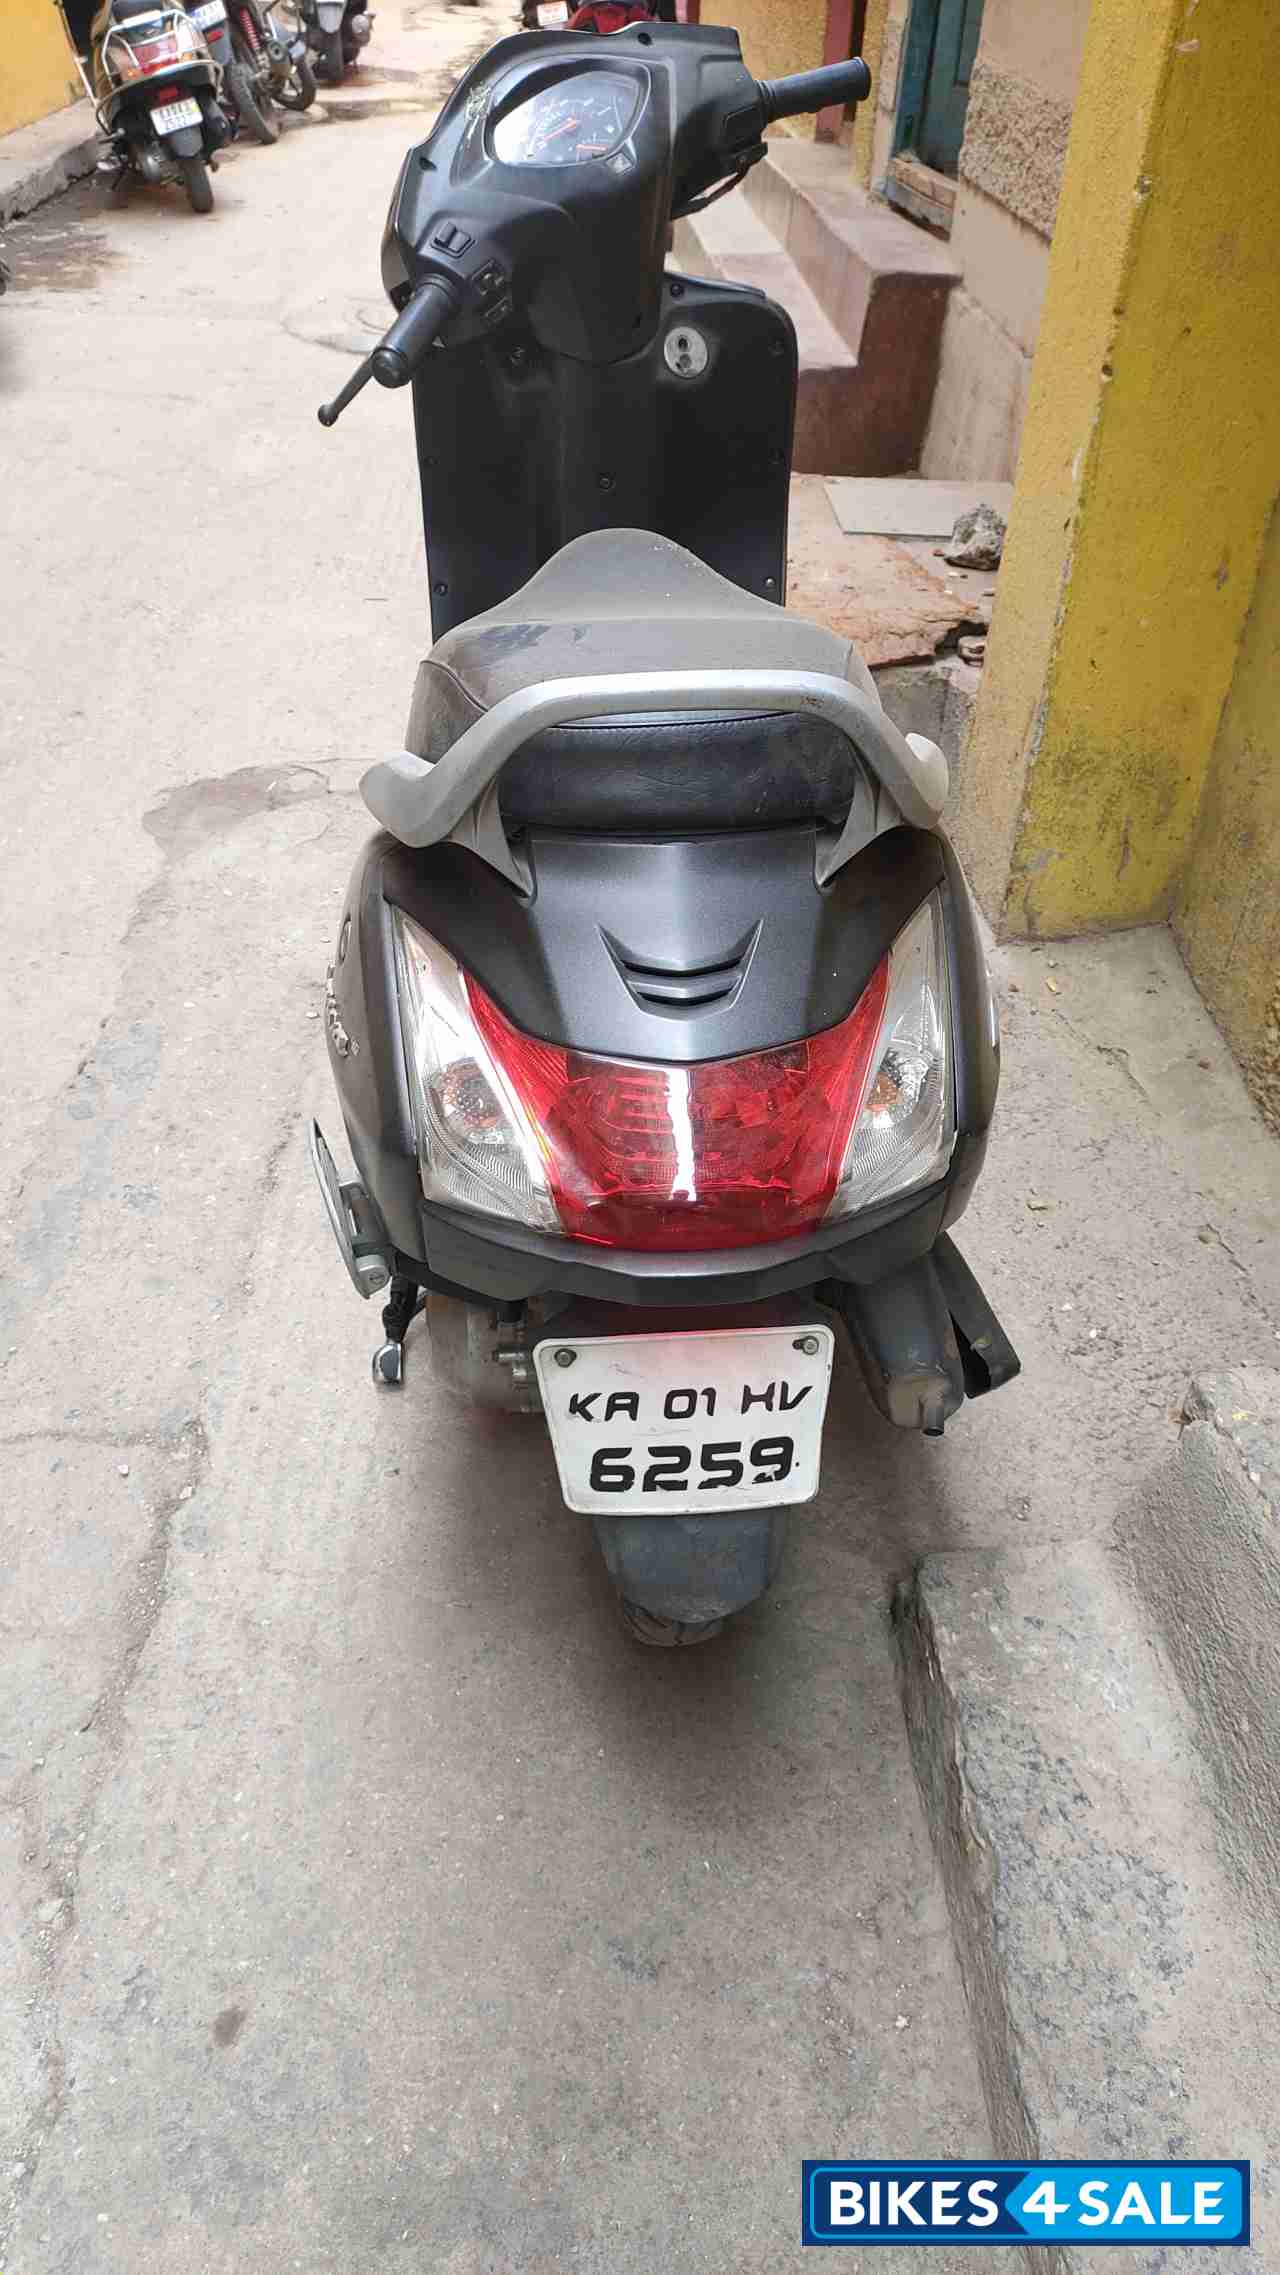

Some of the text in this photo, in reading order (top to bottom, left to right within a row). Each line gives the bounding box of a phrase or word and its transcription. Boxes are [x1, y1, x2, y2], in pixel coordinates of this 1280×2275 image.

[568, 1381, 814, 1422] KA 01 HV
[589, 1436, 796, 1493] 6259
